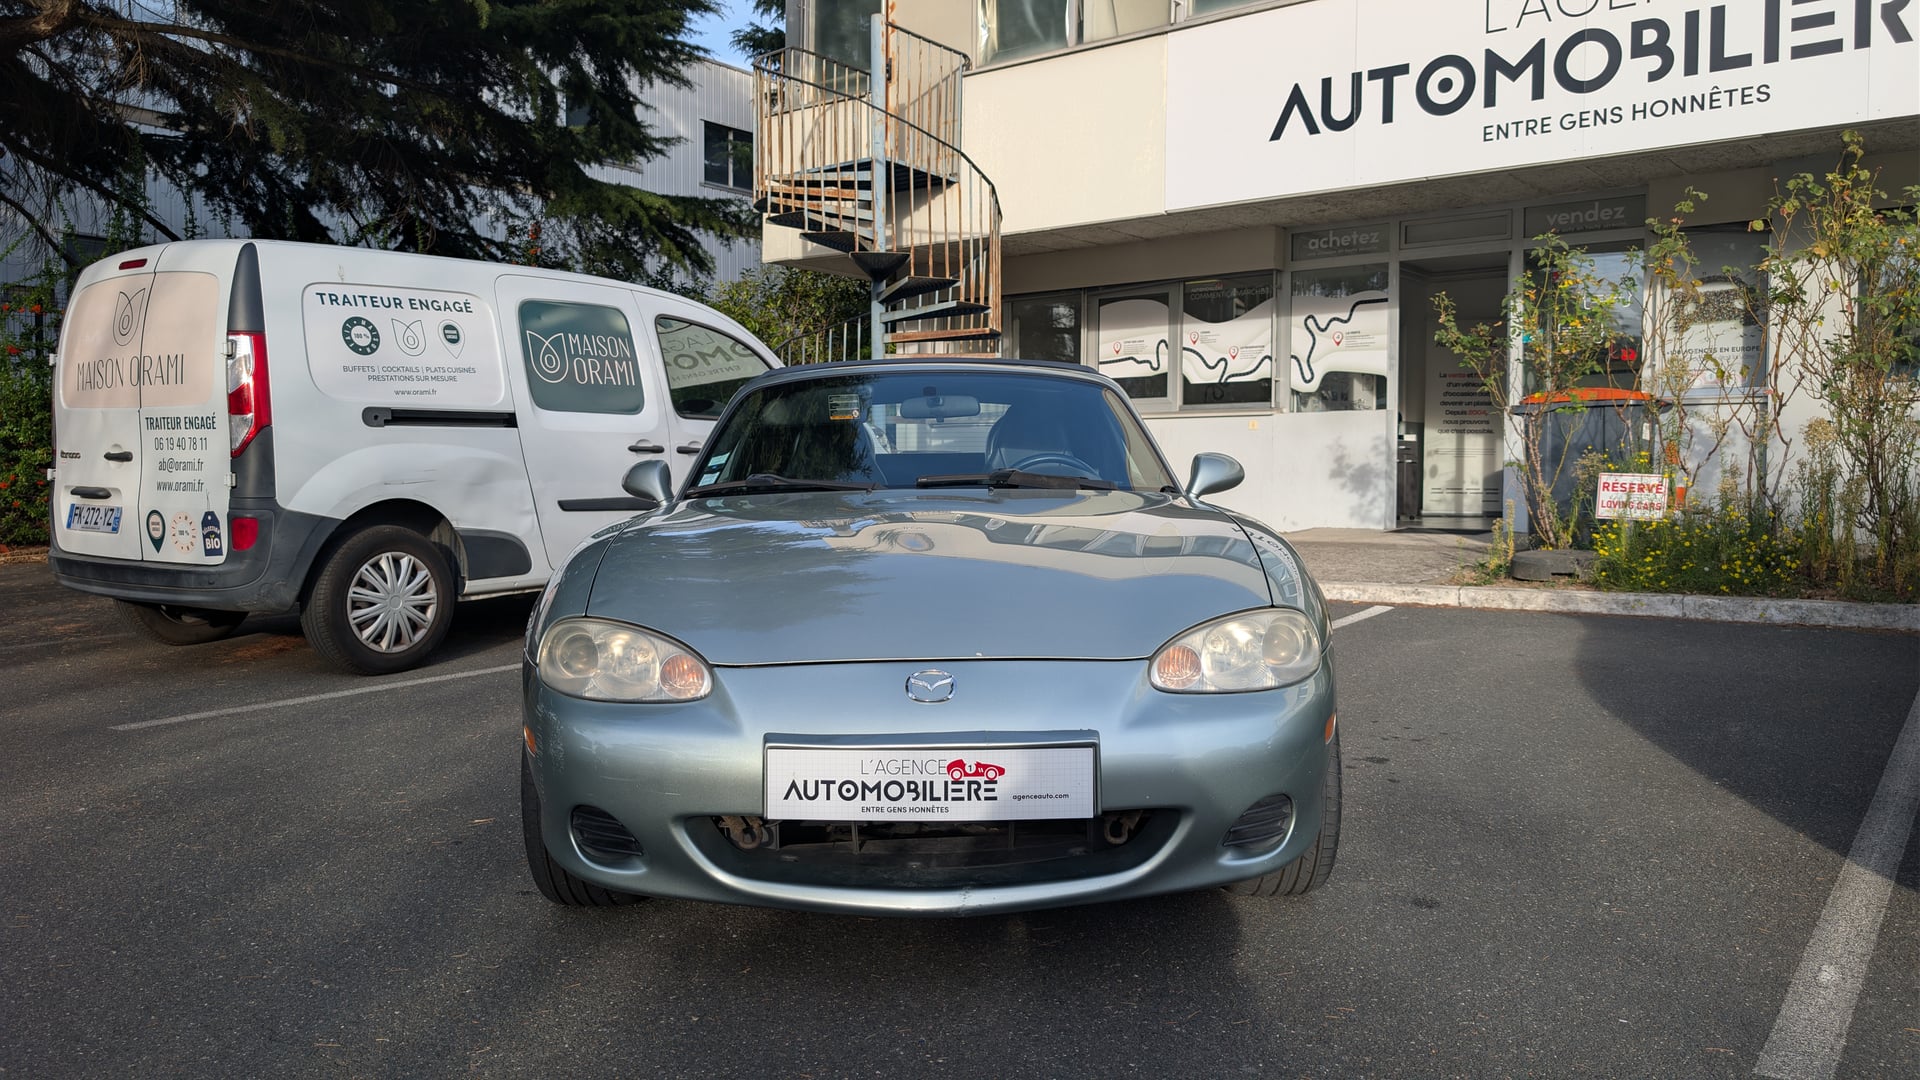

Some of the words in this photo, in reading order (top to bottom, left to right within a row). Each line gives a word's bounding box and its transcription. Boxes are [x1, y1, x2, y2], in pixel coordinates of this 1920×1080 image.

[1483, 118, 1552, 142] ENTRE
[1559, 105, 1624, 131] GENS
[1632, 83, 1771, 121] HONNÊTES
[1546, 201, 1625, 226] vendez
[1308, 230, 1380, 250] achetez
[316, 292, 404, 309] TRAITEUR
[408, 299, 473, 313] ENGAGÉ
[569, 333, 631, 359] MAISON
[77, 358, 124, 391] MAISON
[129, 354, 184, 387] ORAMI
[447, 366, 476, 374] CUISINÉS
[573, 358, 636, 386] ORAMI
[394, 388, 437, 396] www.orami.fr
[145, 416, 182, 431] TRAITEUR
[184, 412, 217, 430] ENGAGÉ
[154, 437, 164, 451] 06
[165, 437, 175, 451] 19
[176, 437, 187, 451] 40
[188, 437, 197, 451] 78
[200, 437, 208, 450] 11
[158, 458, 204, 473] ab@orami.fr
[156, 480, 204, 492] www.orami.fr
[1602, 479, 1663, 494] RÉSERVÉ
[1601, 500, 1634, 509] LOVING
[1636, 501, 1662, 510] CARS
[72, 506, 114, 526] FK-272-YZ
[205, 538, 220, 549] BIO
[861, 759, 947, 775] L'AGENCE
[967, 764, 973, 773] 1
[1012, 792, 1070, 802] agenceauto.com
[861, 806, 885, 814] ENTRE
[886, 806, 907, 814] GENS
[908, 804, 949, 814] HONNÊTES
